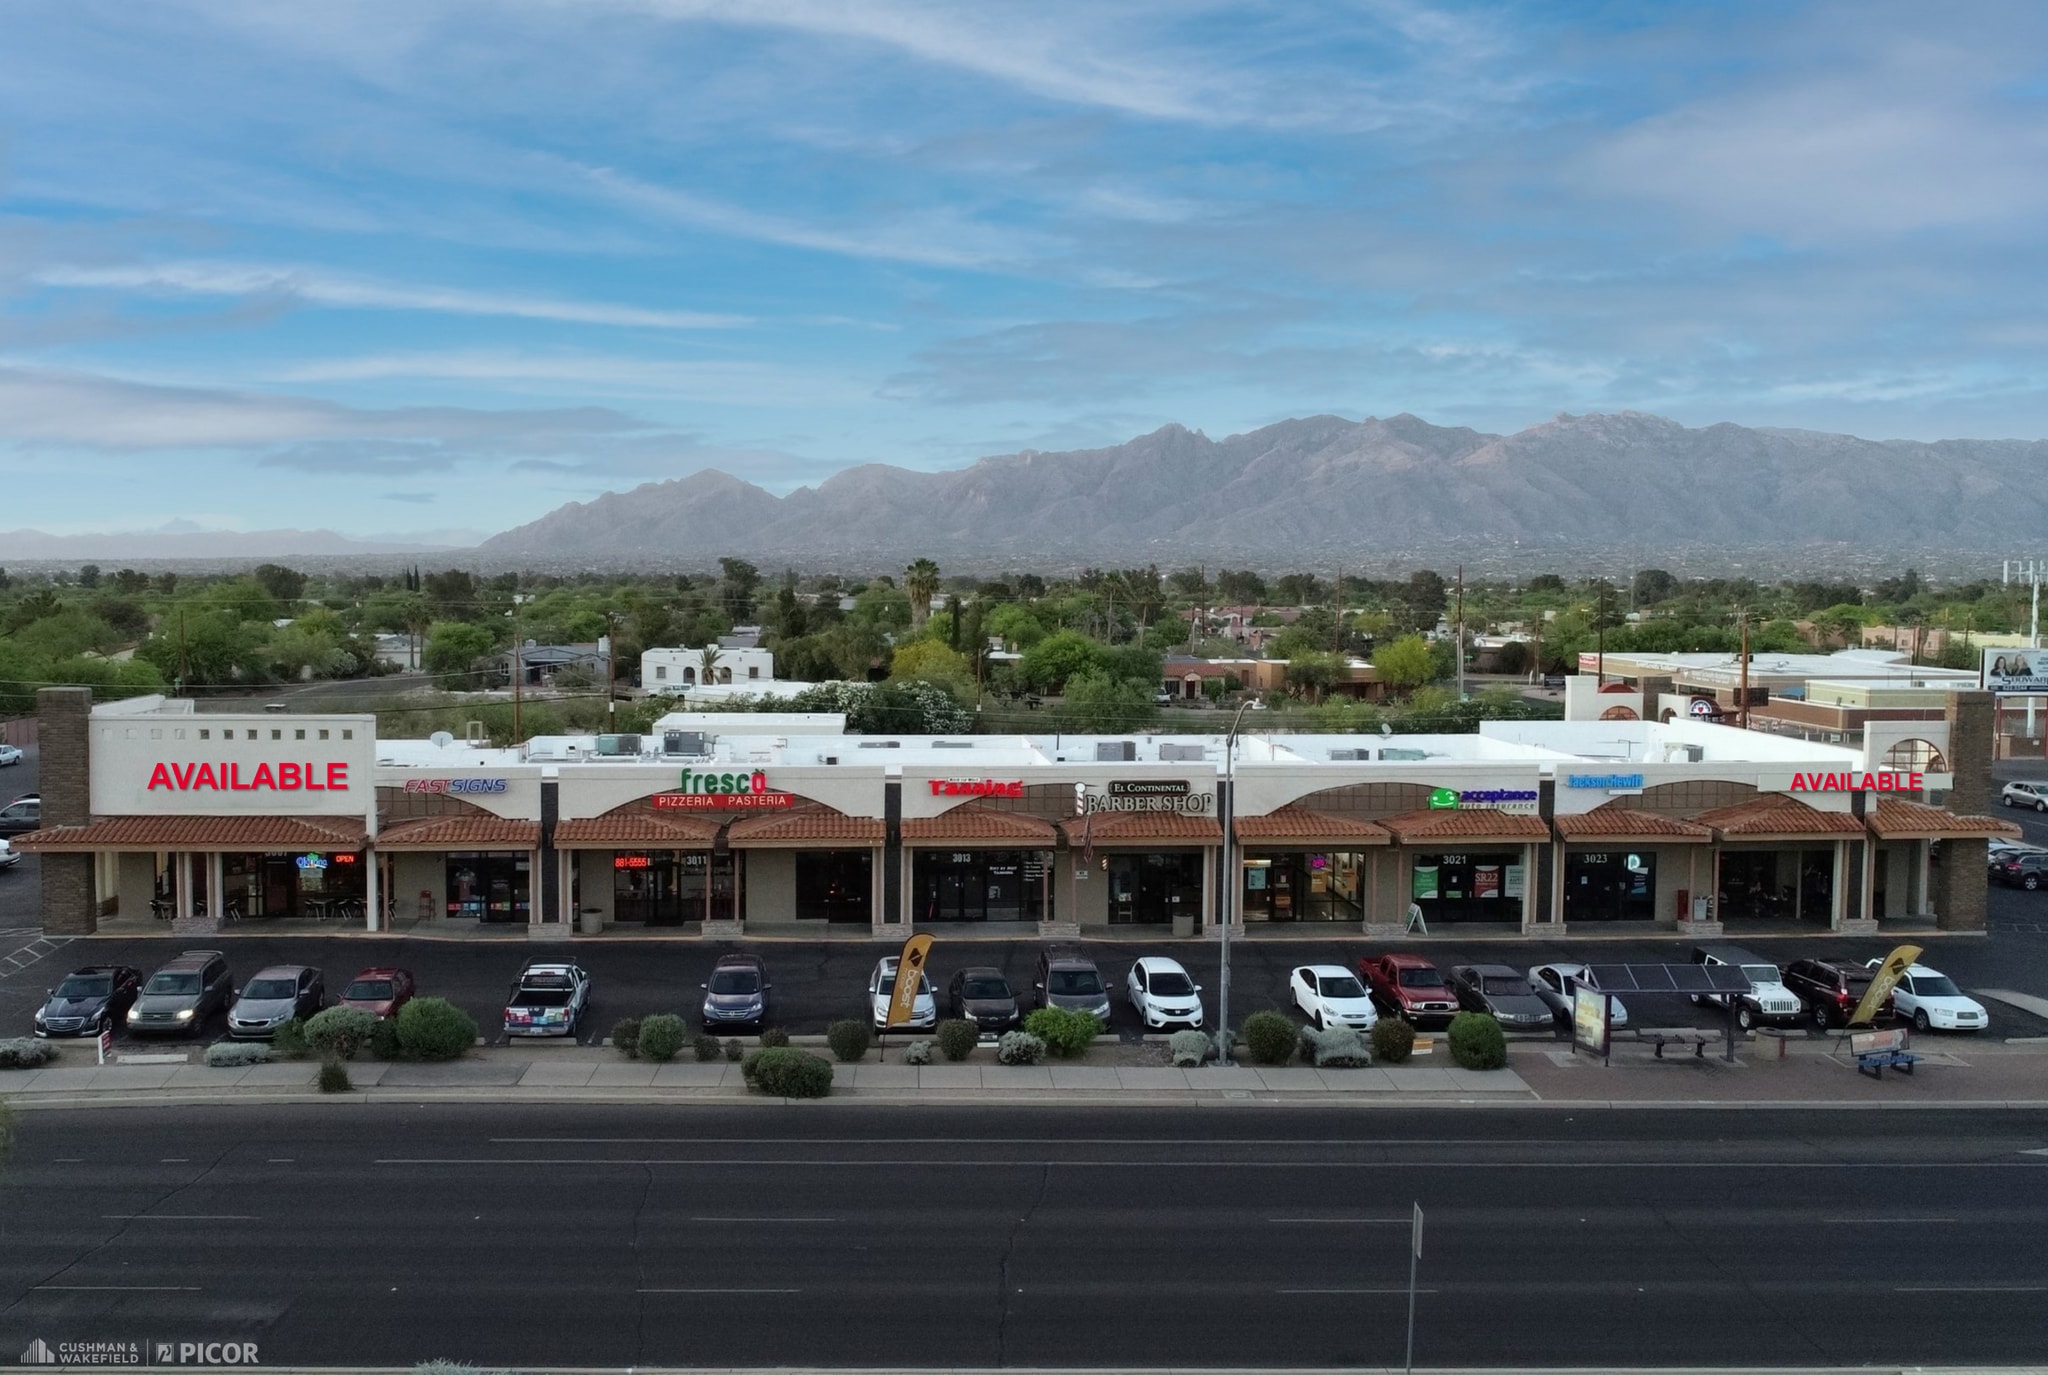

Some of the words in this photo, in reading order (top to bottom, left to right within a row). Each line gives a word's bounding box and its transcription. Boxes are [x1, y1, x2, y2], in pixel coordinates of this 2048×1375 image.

[403, 778, 507, 793] FASTSIGNS
[681, 767, 766, 794] fresco
[928, 779, 1022, 796] Tanning
[659, 796, 714, 806] PIZZERIA
[728, 796, 786, 806] PASTERIA
[1086, 795, 1157, 812] BARBER
[1160, 793, 1213, 812] SHOP
[335, 855, 354, 863] OPEN
[686, 855, 707, 865] 3011
[953, 853, 971, 863] 3013
[1443, 855, 1466, 865] 3021
[1584, 854, 1608, 864] 3023
[1475, 873, 1498, 882] SR22
[901, 969, 919, 1008] boost
